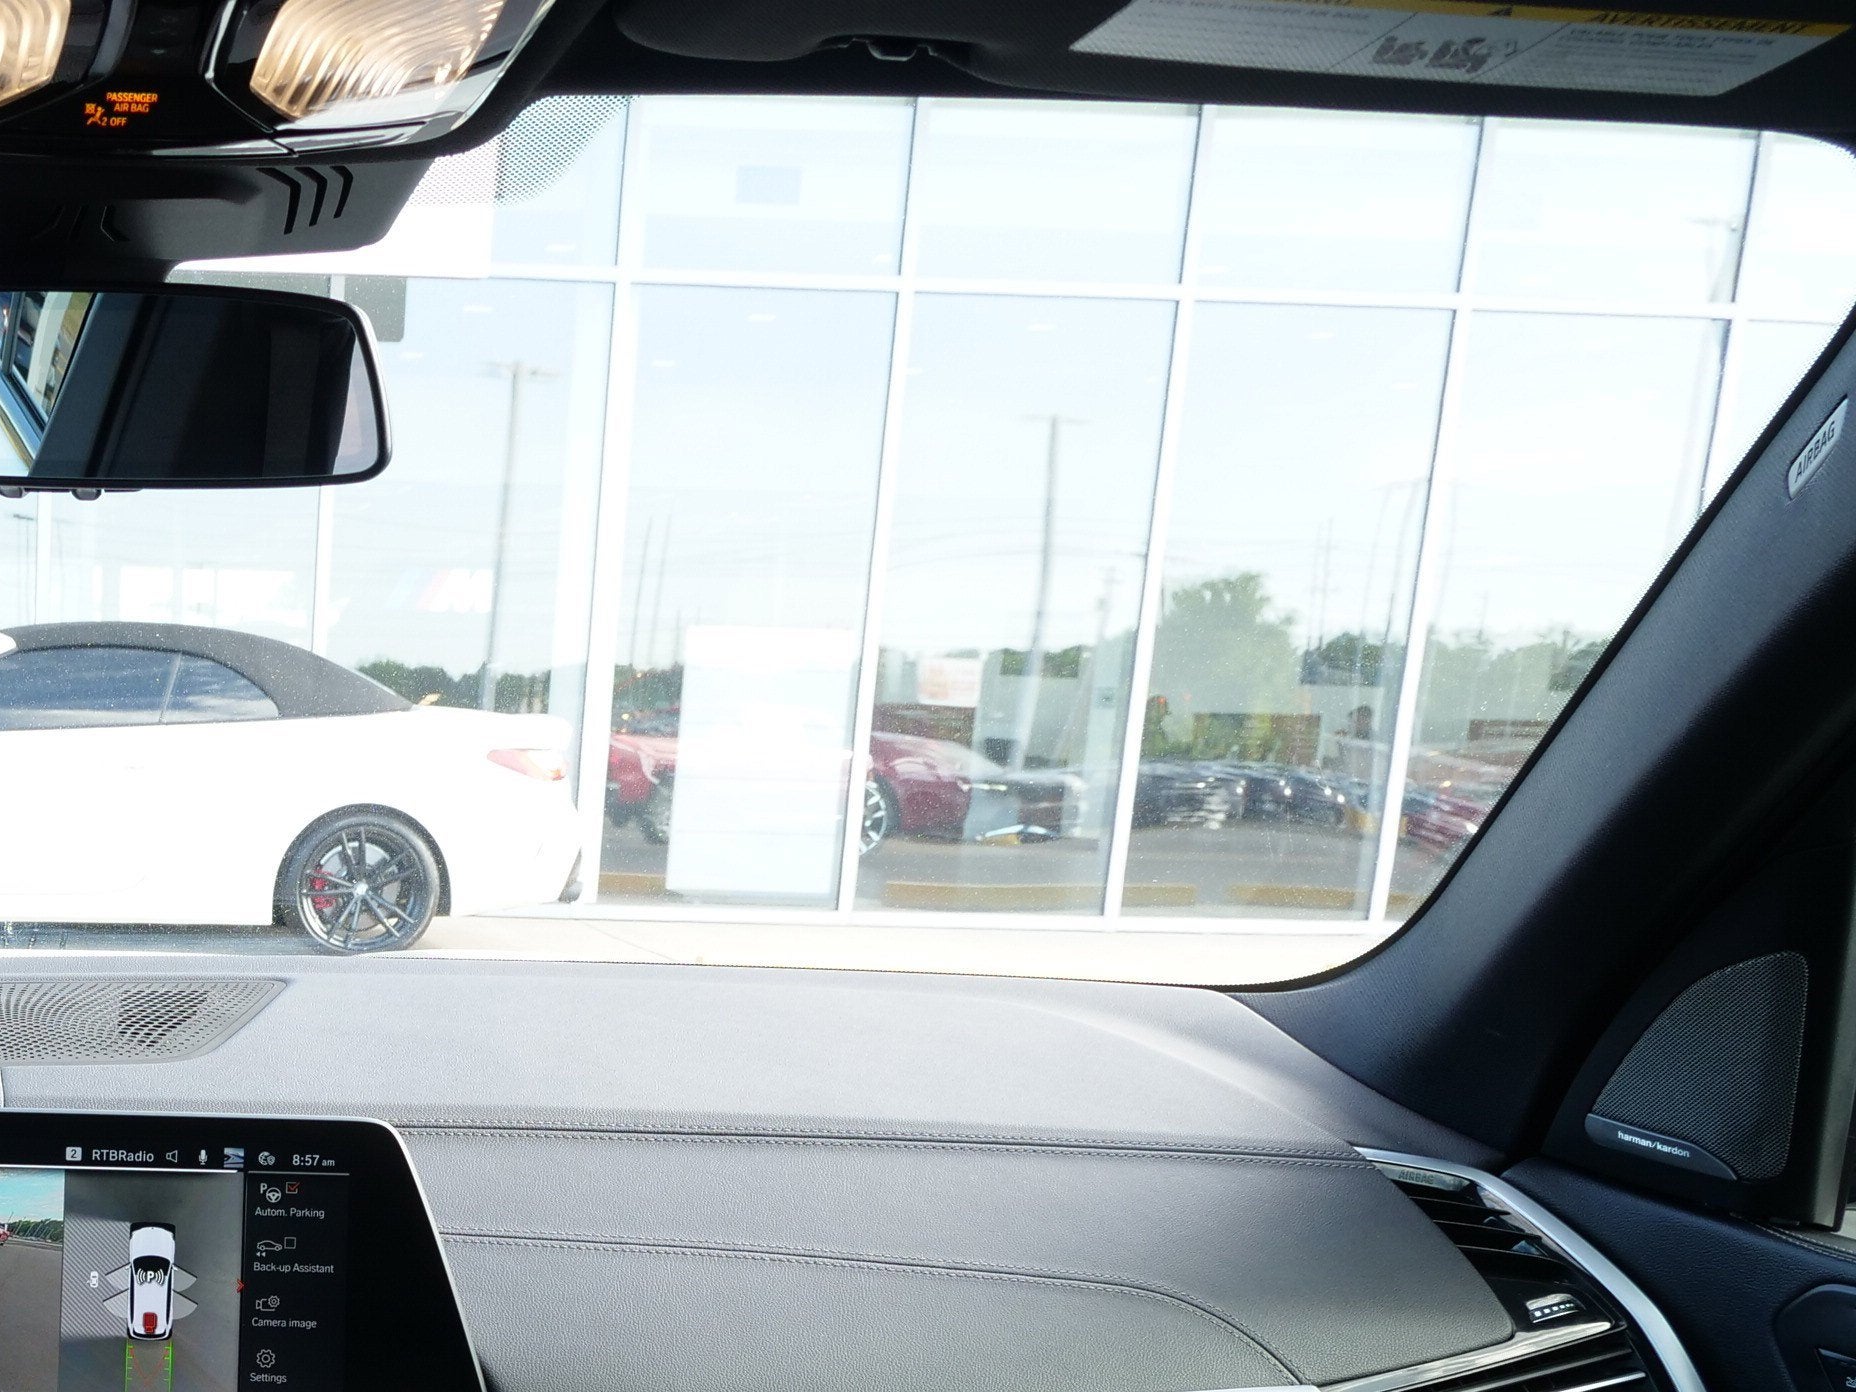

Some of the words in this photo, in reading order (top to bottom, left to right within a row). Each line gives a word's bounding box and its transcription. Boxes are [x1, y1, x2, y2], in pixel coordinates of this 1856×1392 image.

[106, 92, 158, 103] PASSENGER
[114, 103, 129, 112] AIR
[130, 103, 150, 113] BAG
[110, 117, 127, 126] OFF
[1795, 420, 1835, 483] AIRBAG
[1617, 1130, 1690, 1158] harman/kardon
[92, 1150, 154, 1162] RTBRadio
[292, 1154, 320, 1167] 8:57
[321, 1159, 335, 1167] am
[255, 1207, 287, 1217] Autom.
[290, 1207, 325, 1219] Parking
[253, 1262, 291, 1274] Back-up
[293, 1263, 334, 1274] Assistant
[252, 1317, 286, 1328] Camera
[289, 1317, 317, 1329] image
[250, 1373, 287, 1384] Settings
